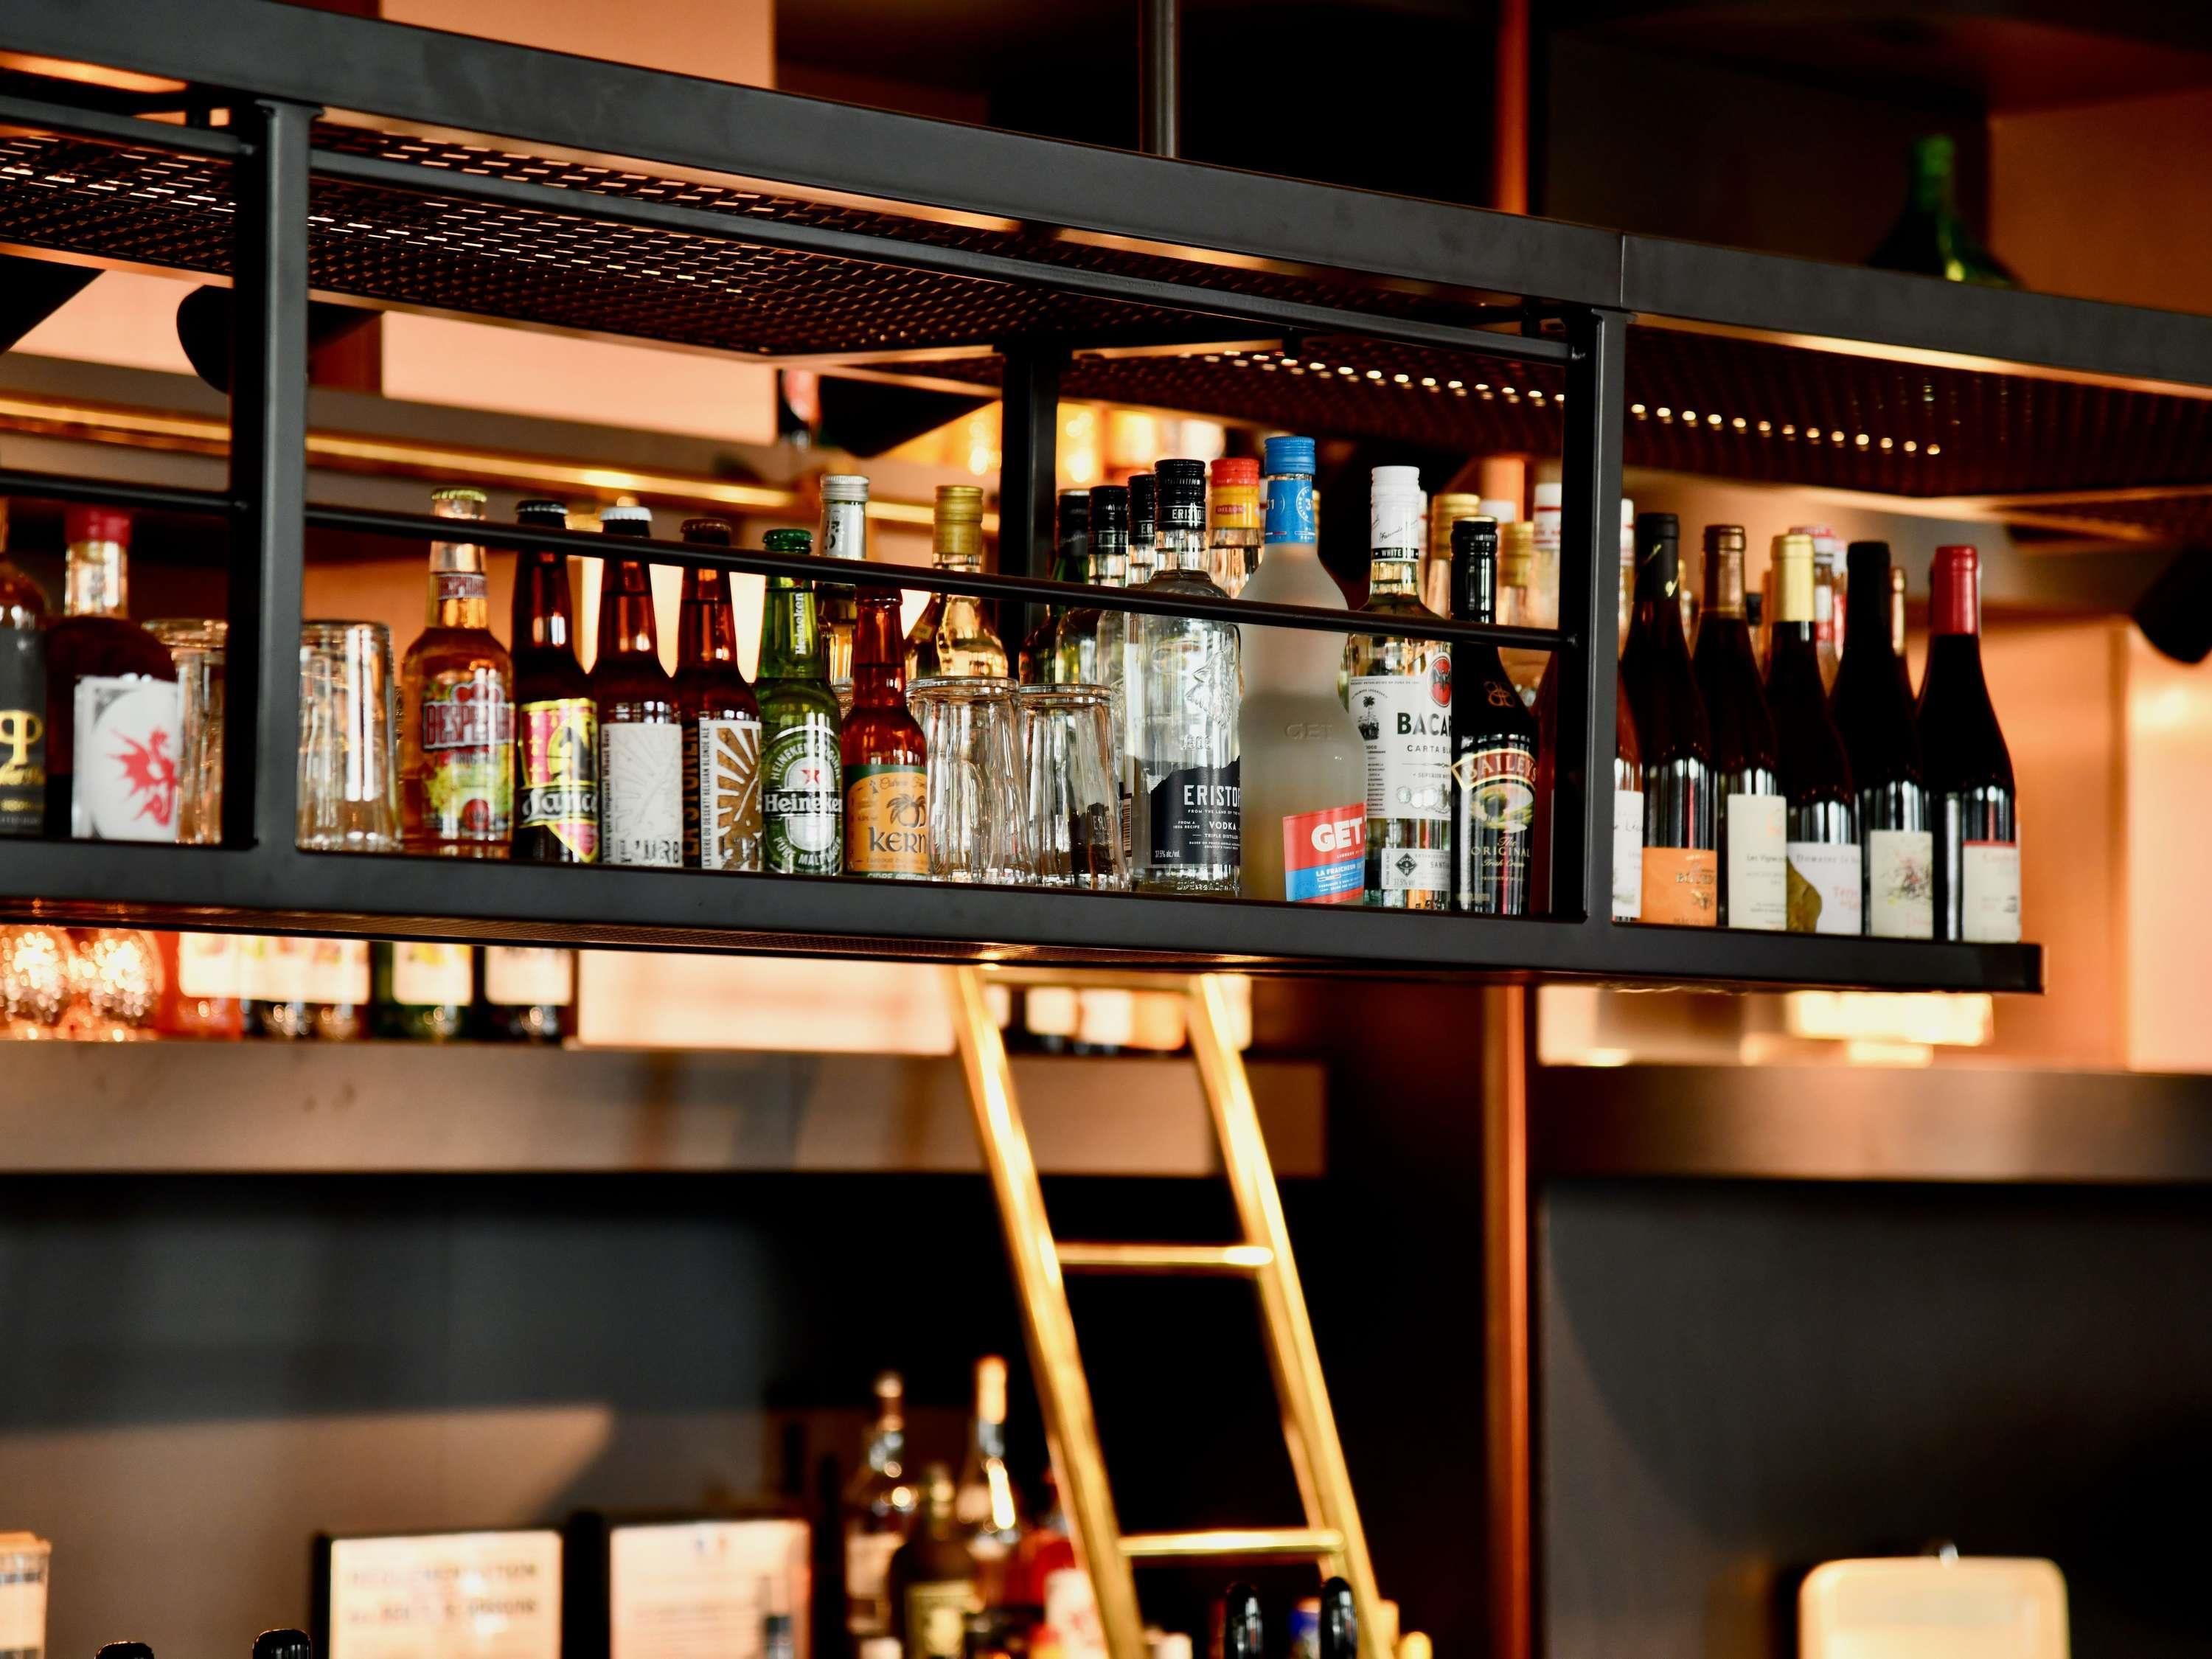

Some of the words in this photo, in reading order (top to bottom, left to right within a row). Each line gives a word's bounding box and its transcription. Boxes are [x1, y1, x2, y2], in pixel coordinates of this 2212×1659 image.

[1407, 745, 1439, 753] CARTA
[1209, 821, 1237, 830] VODKA
[1311, 817, 1363, 852] GET
[1471, 846, 1530, 858] ORIGINAL
